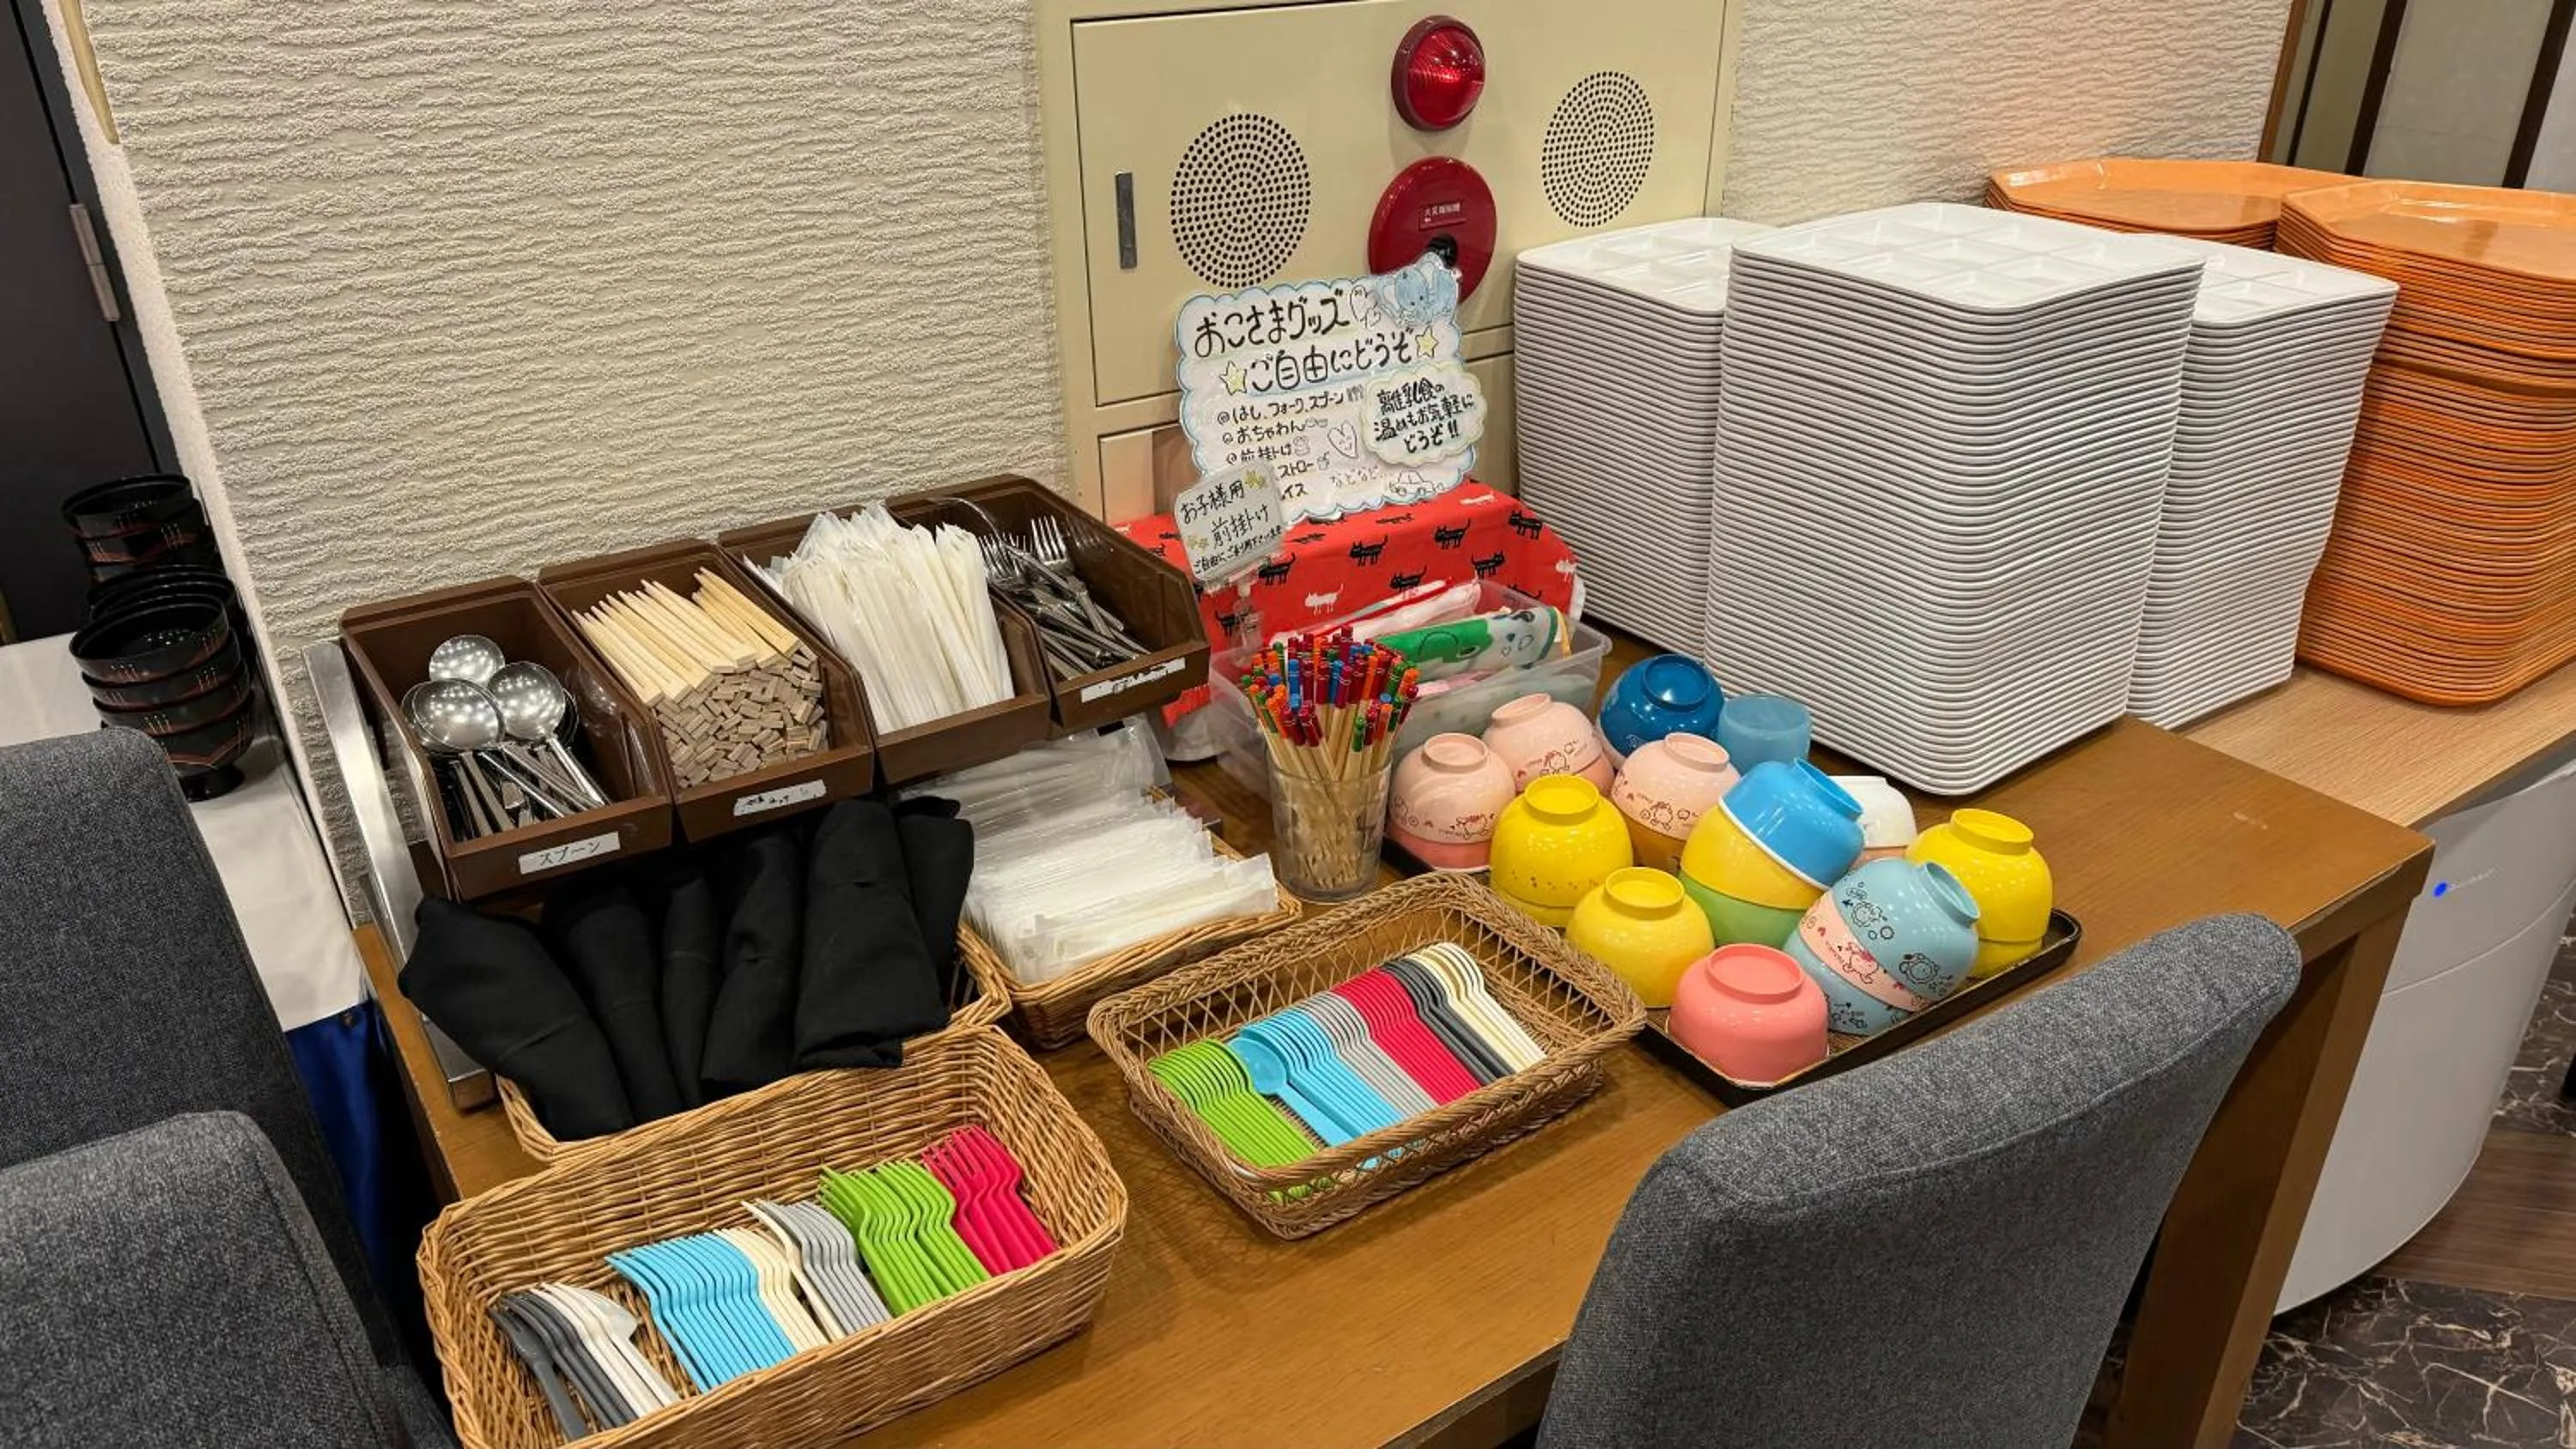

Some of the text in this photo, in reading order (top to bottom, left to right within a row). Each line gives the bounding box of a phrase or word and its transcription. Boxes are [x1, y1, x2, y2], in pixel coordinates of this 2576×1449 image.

[1194, 288, 1351, 358] おこさまグッズ
[1251, 327, 1413, 392] ご自由にどうぞ
[1376, 377, 1445, 415] 離乳食の
[1236, 420, 1306, 445] おちゃわん
[1277, 459, 1315, 478] ストロー
[1181, 479, 1245, 524] お子様用
[1281, 483, 1308, 501] イス
[1212, 503, 1269, 549] 前掛け
